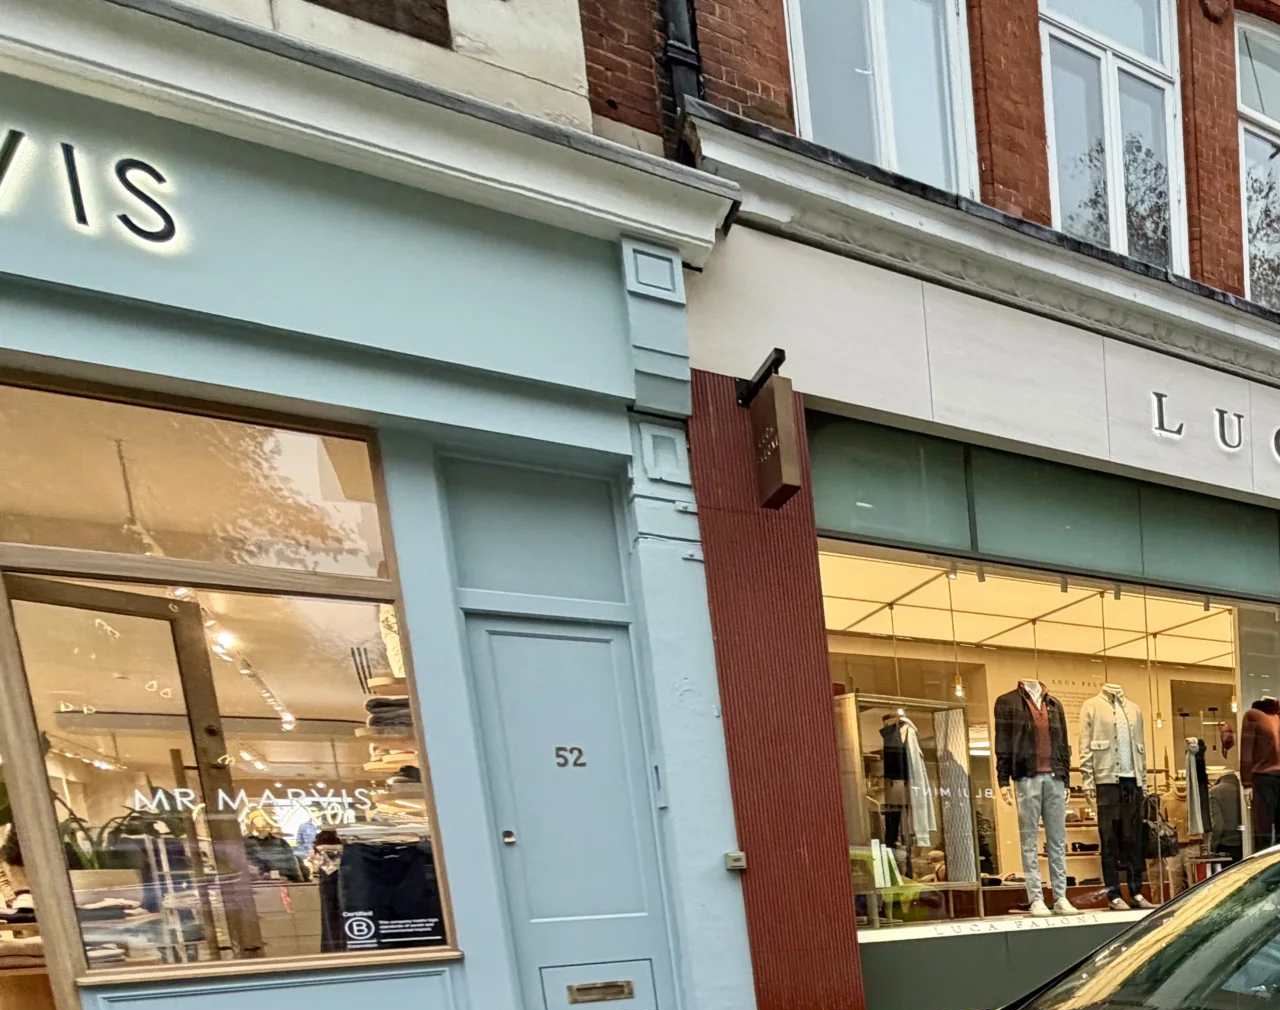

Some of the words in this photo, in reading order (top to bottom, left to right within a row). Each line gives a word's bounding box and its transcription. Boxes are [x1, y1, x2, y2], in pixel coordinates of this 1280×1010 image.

[555, 746, 588, 768] 52
[133, 788, 196, 811] MR
[217, 788, 373, 811] MARVIS
[934, 923, 998, 935] LUCA
[1014, 914, 1100, 929] FALONI
